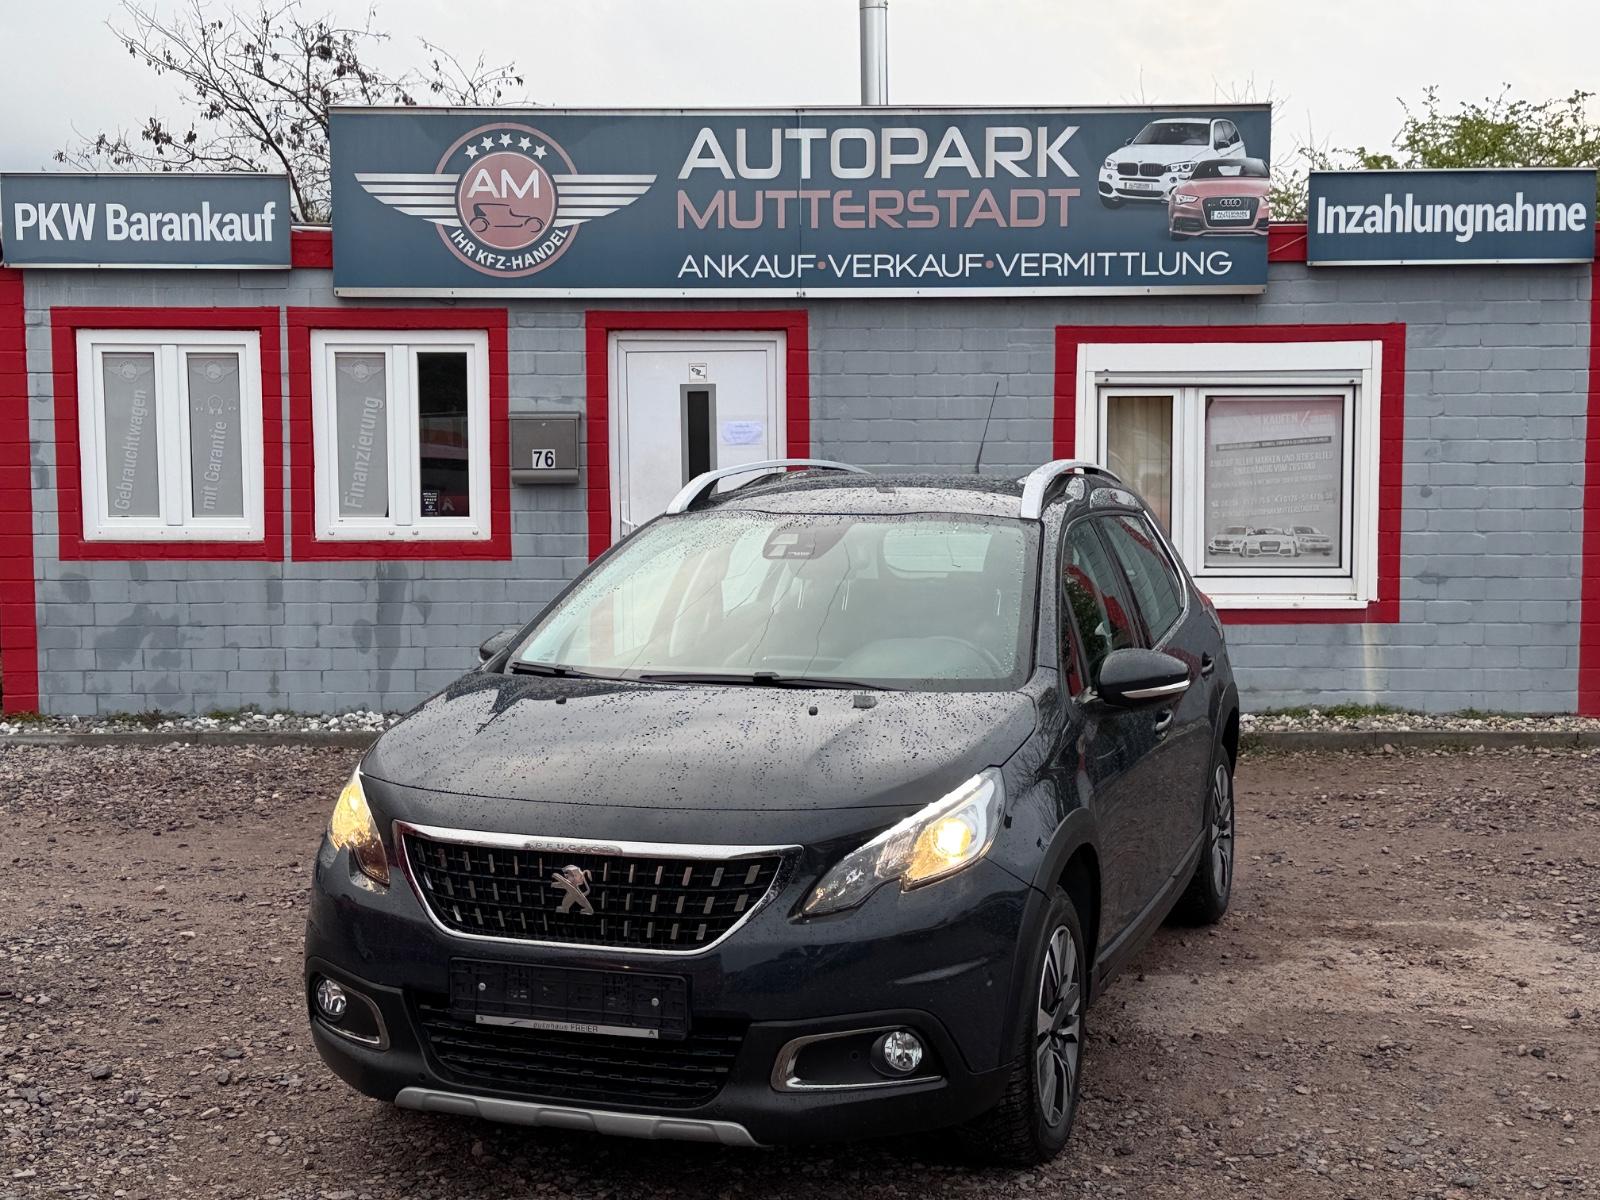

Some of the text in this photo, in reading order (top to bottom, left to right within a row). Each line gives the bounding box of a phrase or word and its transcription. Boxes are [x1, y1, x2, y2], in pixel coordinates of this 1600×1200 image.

[677, 126, 1081, 180] AUTOPARK
[466, 168, 541, 199] AM
[14, 201, 276, 242] PKW Barankauf
[677, 188, 1081, 230] MUTTERSTADT
[1316, 191, 1588, 243] Inzahlungnahme
[450, 228, 570, 270] IHR KFZ-HANDEL
[677, 250, 1234, 279] ANKAUF VERKAUF VERMITTLUNG
[113, 388, 149, 511] Gebrauchtwagen
[202, 420, 228, 510] mit Garantie
[344, 395, 385, 509] Finanzierung
[533, 450, 555, 468] 76
